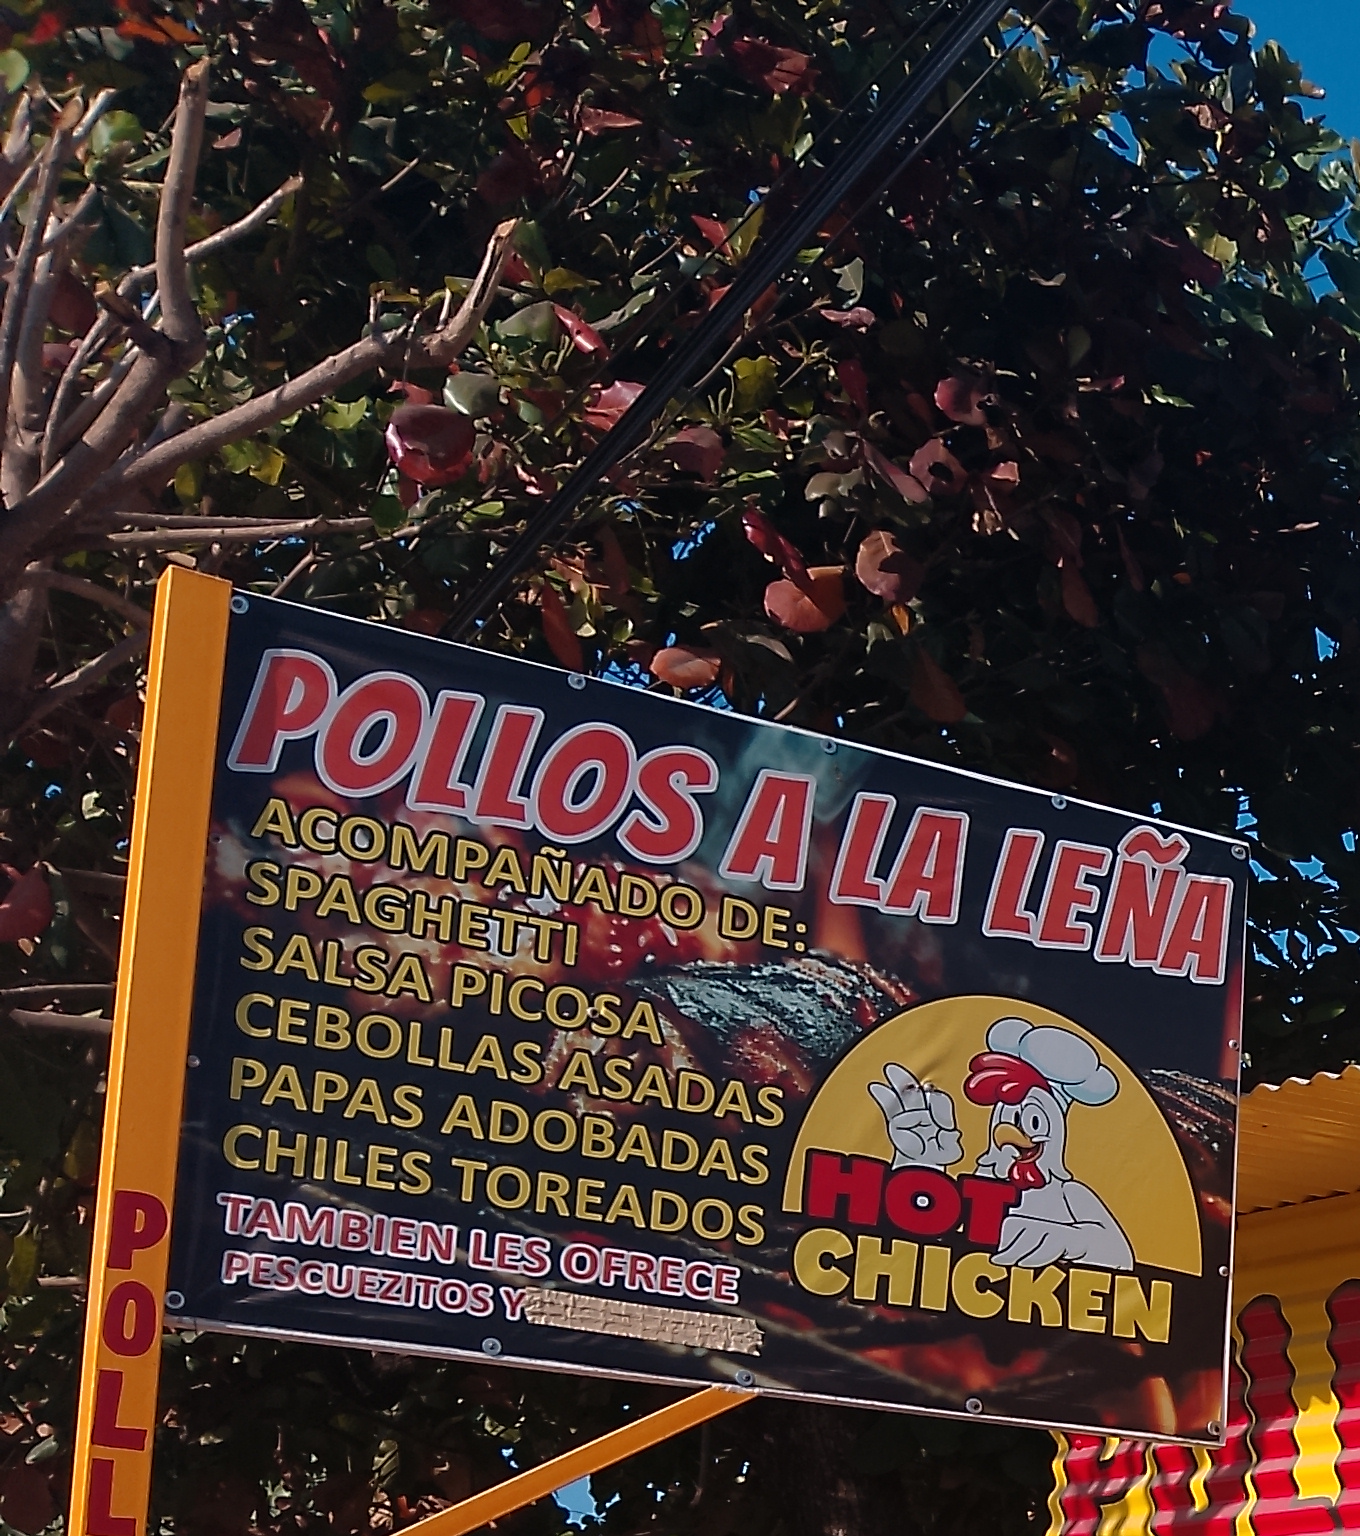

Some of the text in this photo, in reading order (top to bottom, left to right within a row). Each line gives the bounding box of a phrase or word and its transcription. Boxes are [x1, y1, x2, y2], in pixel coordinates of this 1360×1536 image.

[227, 649, 1235, 984] POLLOS A LA LEÑA
[251, 798, 807, 952] ACOMPAÑADO DE:
[246, 862, 579, 965] SPAGHETTI
[240, 927, 663, 1044] SALSA PICOSA
[235, 992, 784, 1127] CEBOLLAS ASADAS
[229, 1057, 770, 1184] PAPAS ADOBADAS
[222, 1124, 765, 1245] CHILES TOREADOS
[808, 1152, 1018, 1245] HOT
[217, 1193, 740, 1302] TAMBIEN LES OFRECE
[222, 1251, 526, 1320] PESCUEZITOS Y
[793, 1227, 1173, 1343] CHICKEN
